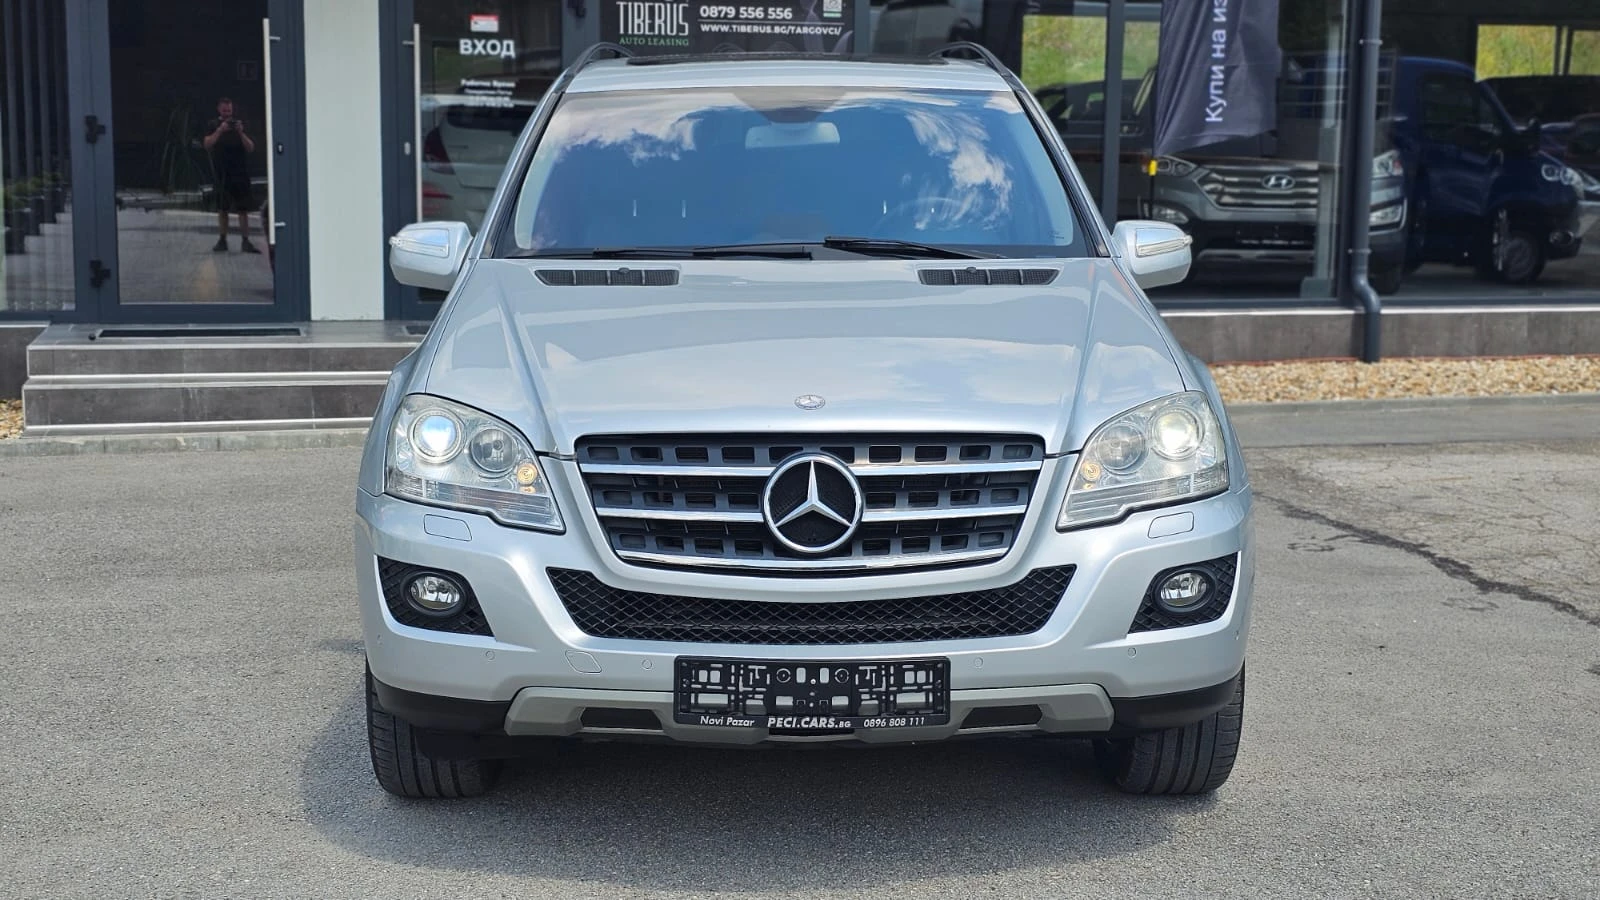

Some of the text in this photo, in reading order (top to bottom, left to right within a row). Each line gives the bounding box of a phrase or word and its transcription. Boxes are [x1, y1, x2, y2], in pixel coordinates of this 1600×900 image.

[616, 1, 689, 36] TIBERUS
[699, 5, 793, 20] 0879 556 556
[459, 38, 516, 59] ВХОД
[619, 37, 689, 47] AUTO LEASING
[1212, 29, 1227, 58] на
[1205, 65, 1227, 122] Купи
[700, 715, 724, 726] Novi
[727, 716, 755, 727] Pazar
[863, 718, 887, 728] 0896
[888, 718, 906, 726] 808
[909, 717, 925, 726] 111
